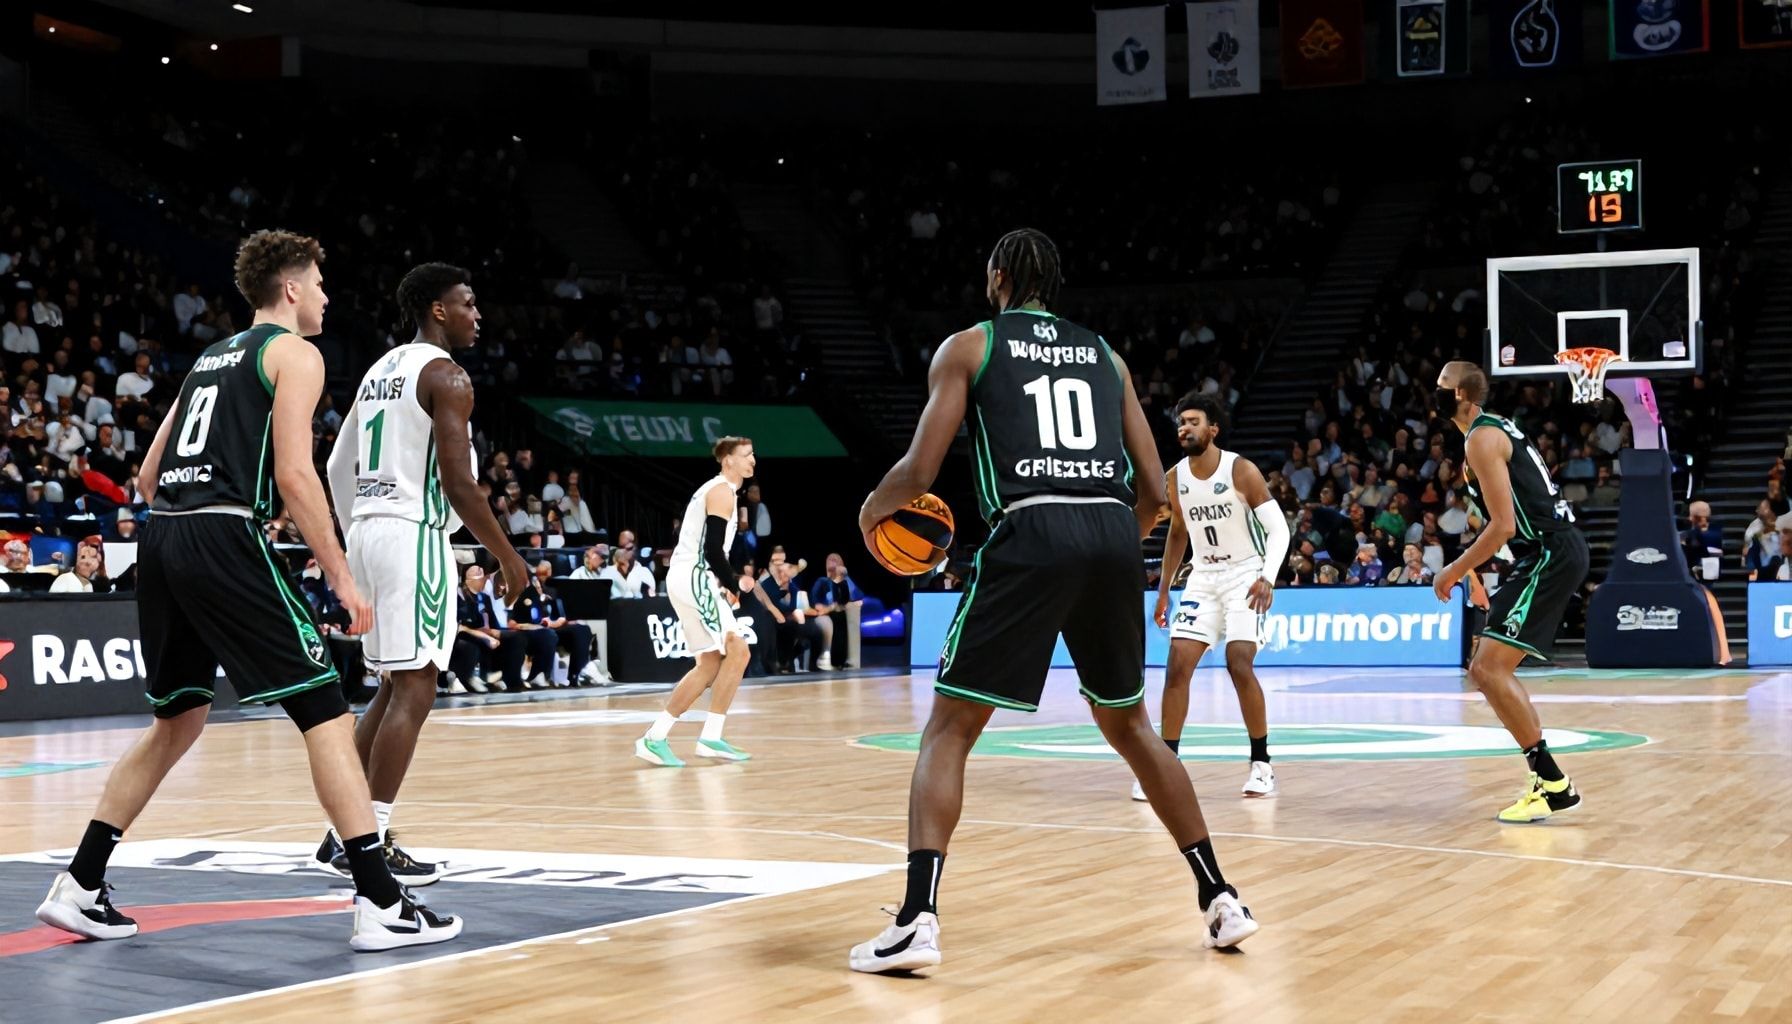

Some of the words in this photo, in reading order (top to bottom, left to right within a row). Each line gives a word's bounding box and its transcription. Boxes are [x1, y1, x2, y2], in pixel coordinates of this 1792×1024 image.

[1588, 193, 1622, 223] 15
[1023, 374, 1098, 451] 10
[365, 408, 385, 472] 1
[1204, 525, 1219, 547] 0
